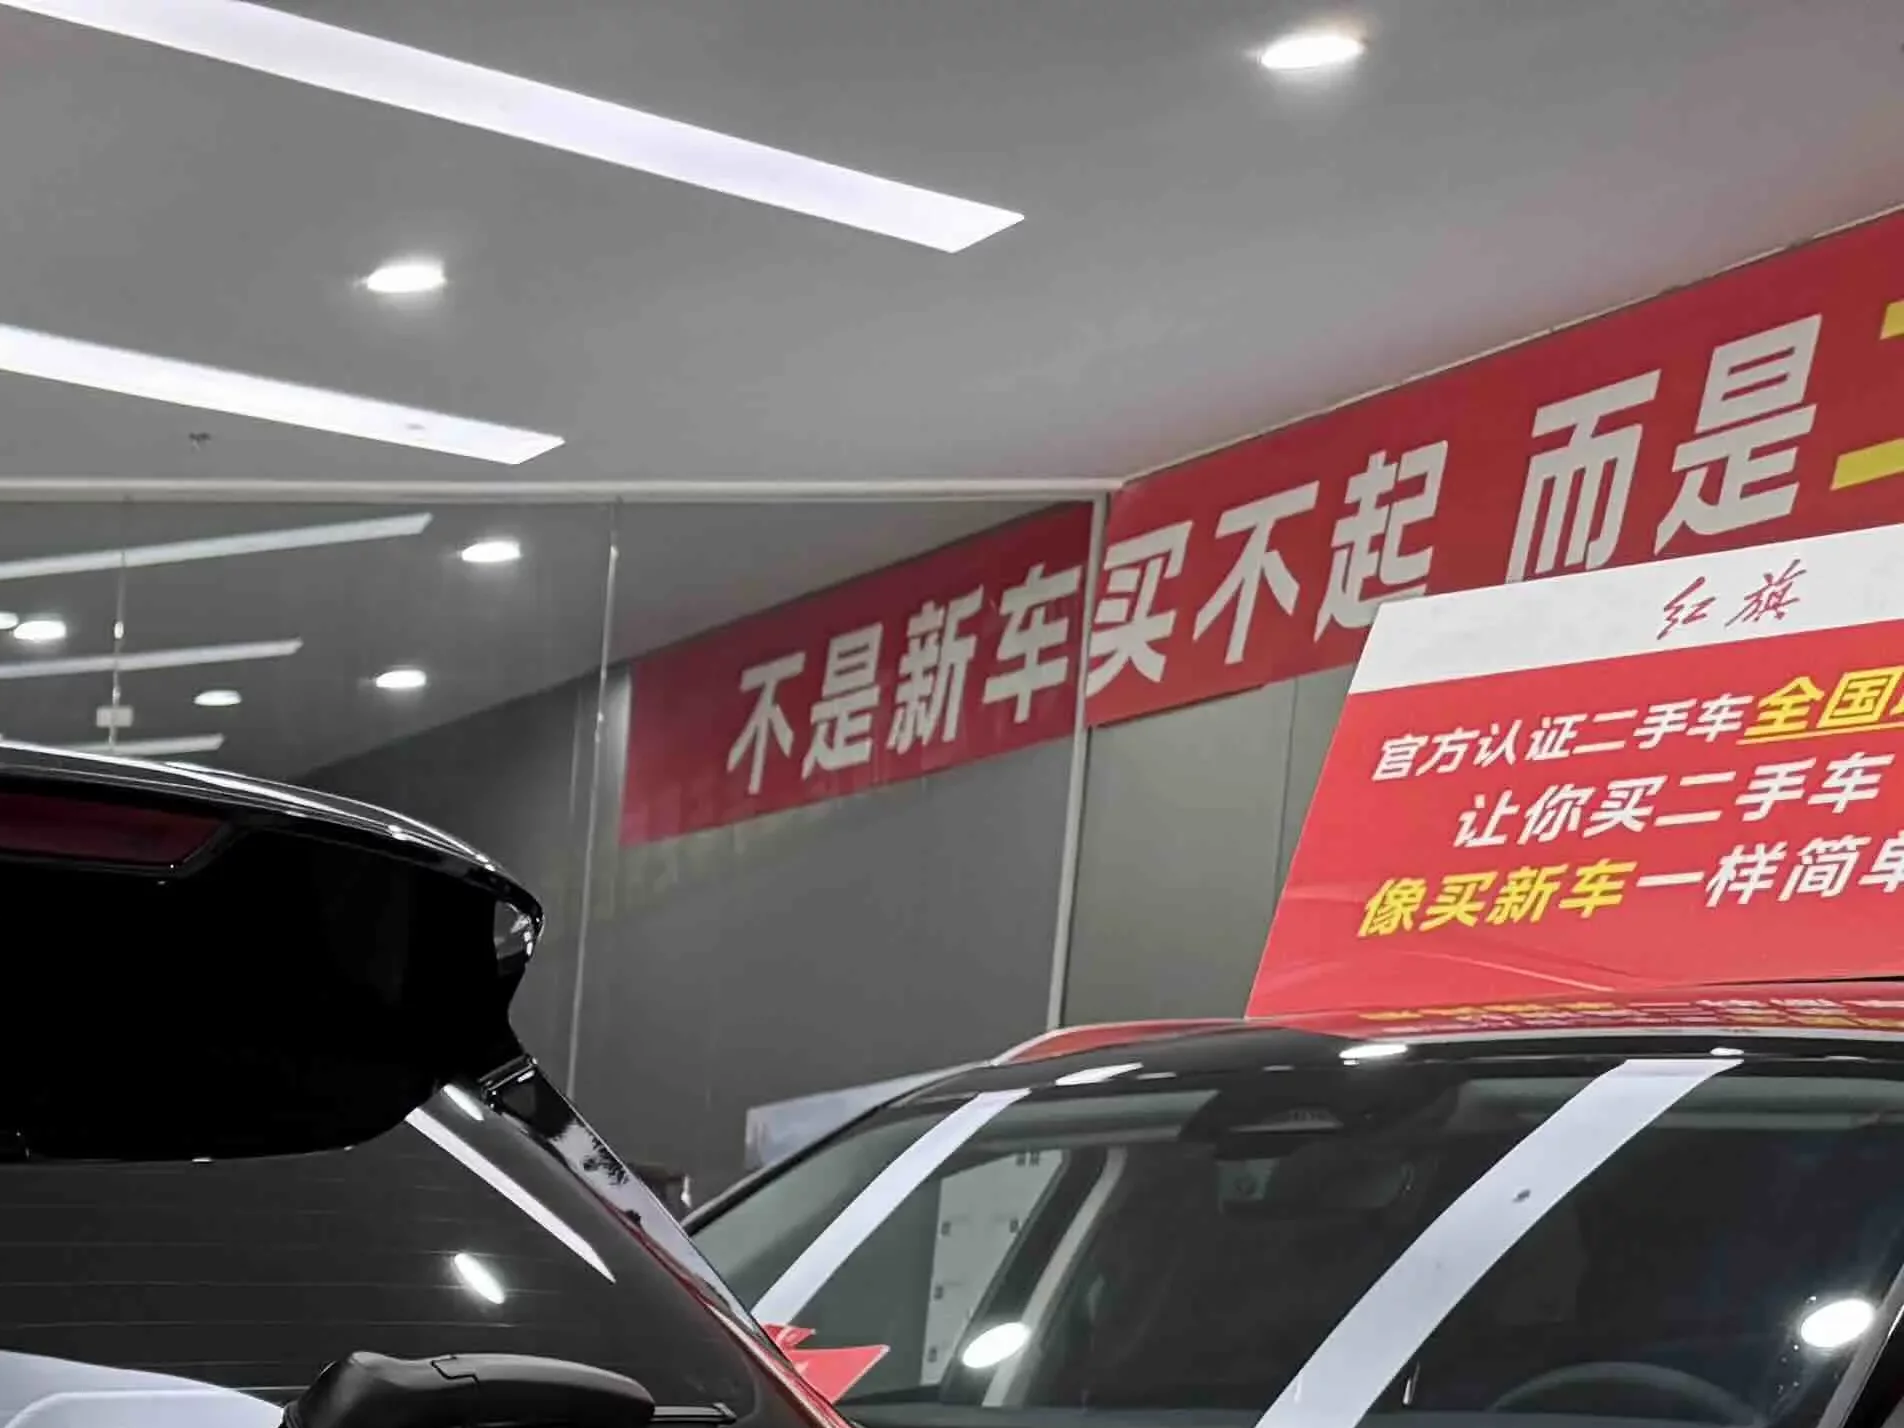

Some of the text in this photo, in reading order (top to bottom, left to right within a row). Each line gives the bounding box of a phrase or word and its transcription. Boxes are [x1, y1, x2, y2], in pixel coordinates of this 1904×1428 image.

[1656, 558, 1808, 640] 红旗
[1372, 664, 1904, 782] 官方认证二手车全国
[1453, 752, 1895, 849] 让你买二手车
